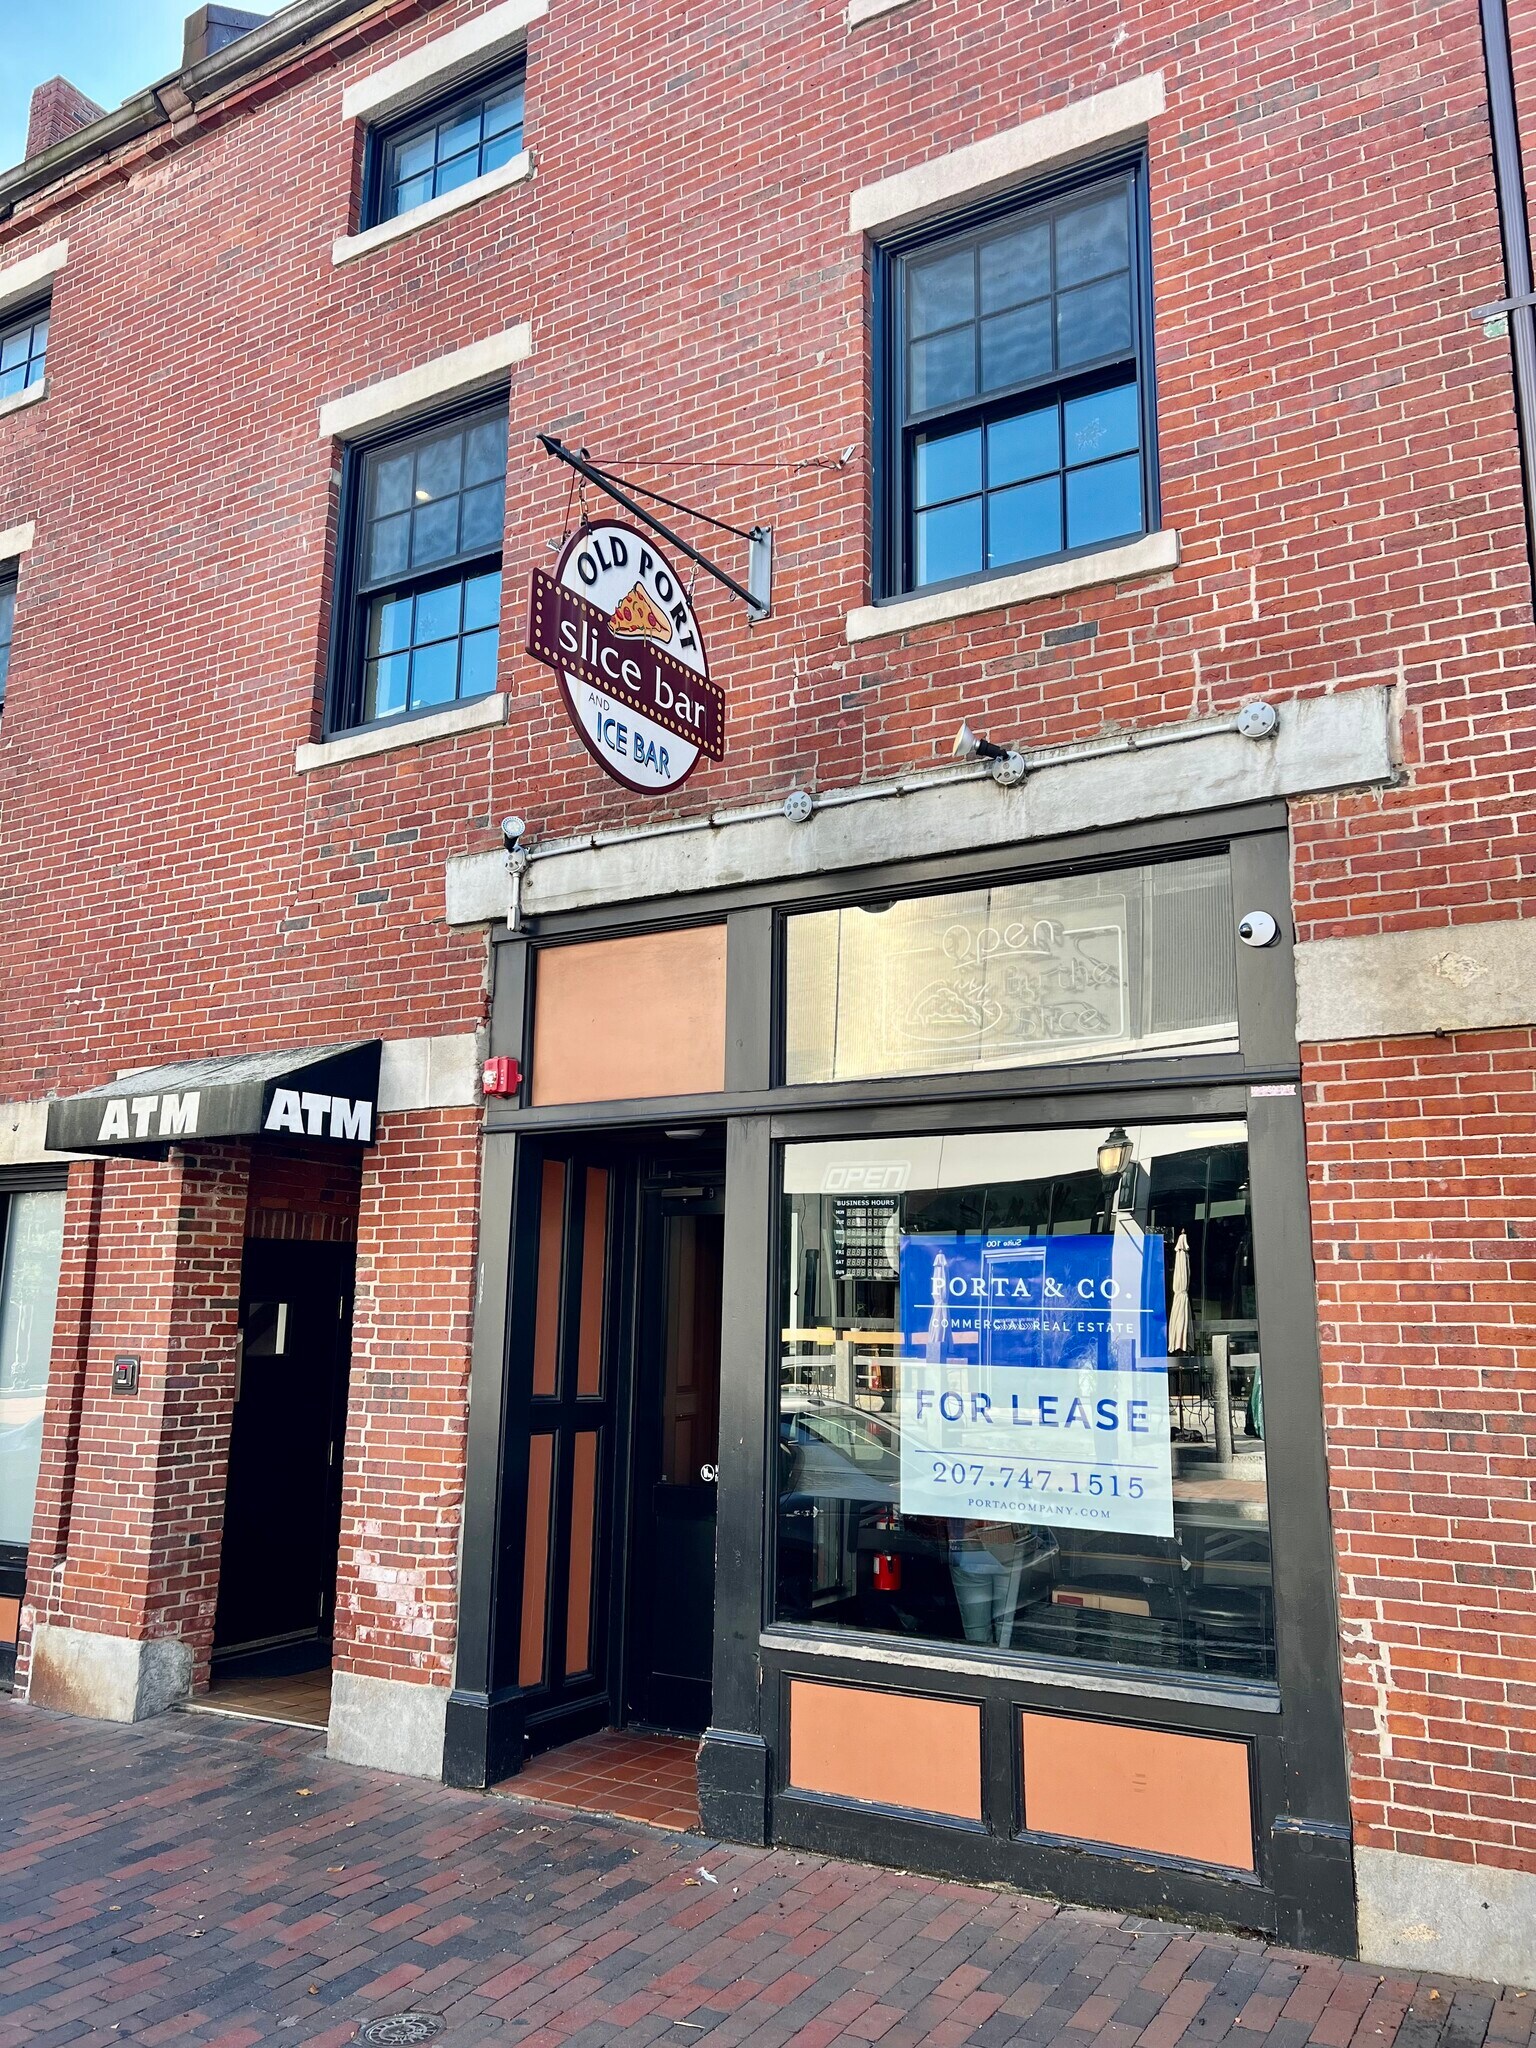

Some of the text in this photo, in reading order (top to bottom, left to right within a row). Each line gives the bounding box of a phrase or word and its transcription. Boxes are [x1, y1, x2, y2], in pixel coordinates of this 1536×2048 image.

[577, 535, 697, 651] OLD PORT
[558, 619, 705, 729] slice bar
[588, 692, 610, 711] AND
[596, 711, 671, 779] ICE BAR
[942, 920, 1055, 964] Open
[97, 1091, 201, 1141] ATM
[264, 1087, 373, 1142] ATM
[825, 1167, 905, 1190] OPEN
[836, 1199, 870, 1207] BUSINESS
[930, 1277, 1133, 1299] PORTA & CO.
[932, 1318, 1025, 1332] COMMERCIAL
[1033, 1321, 1070, 1332] REAL
[1078, 1322, 1134, 1333] ESTATE
[916, 1389, 1149, 1433] FOR LEASE
[932, 1461, 1144, 1499] 207.747.1515
[968, 1498, 1111, 1519] PORTACOMPANY.COM
